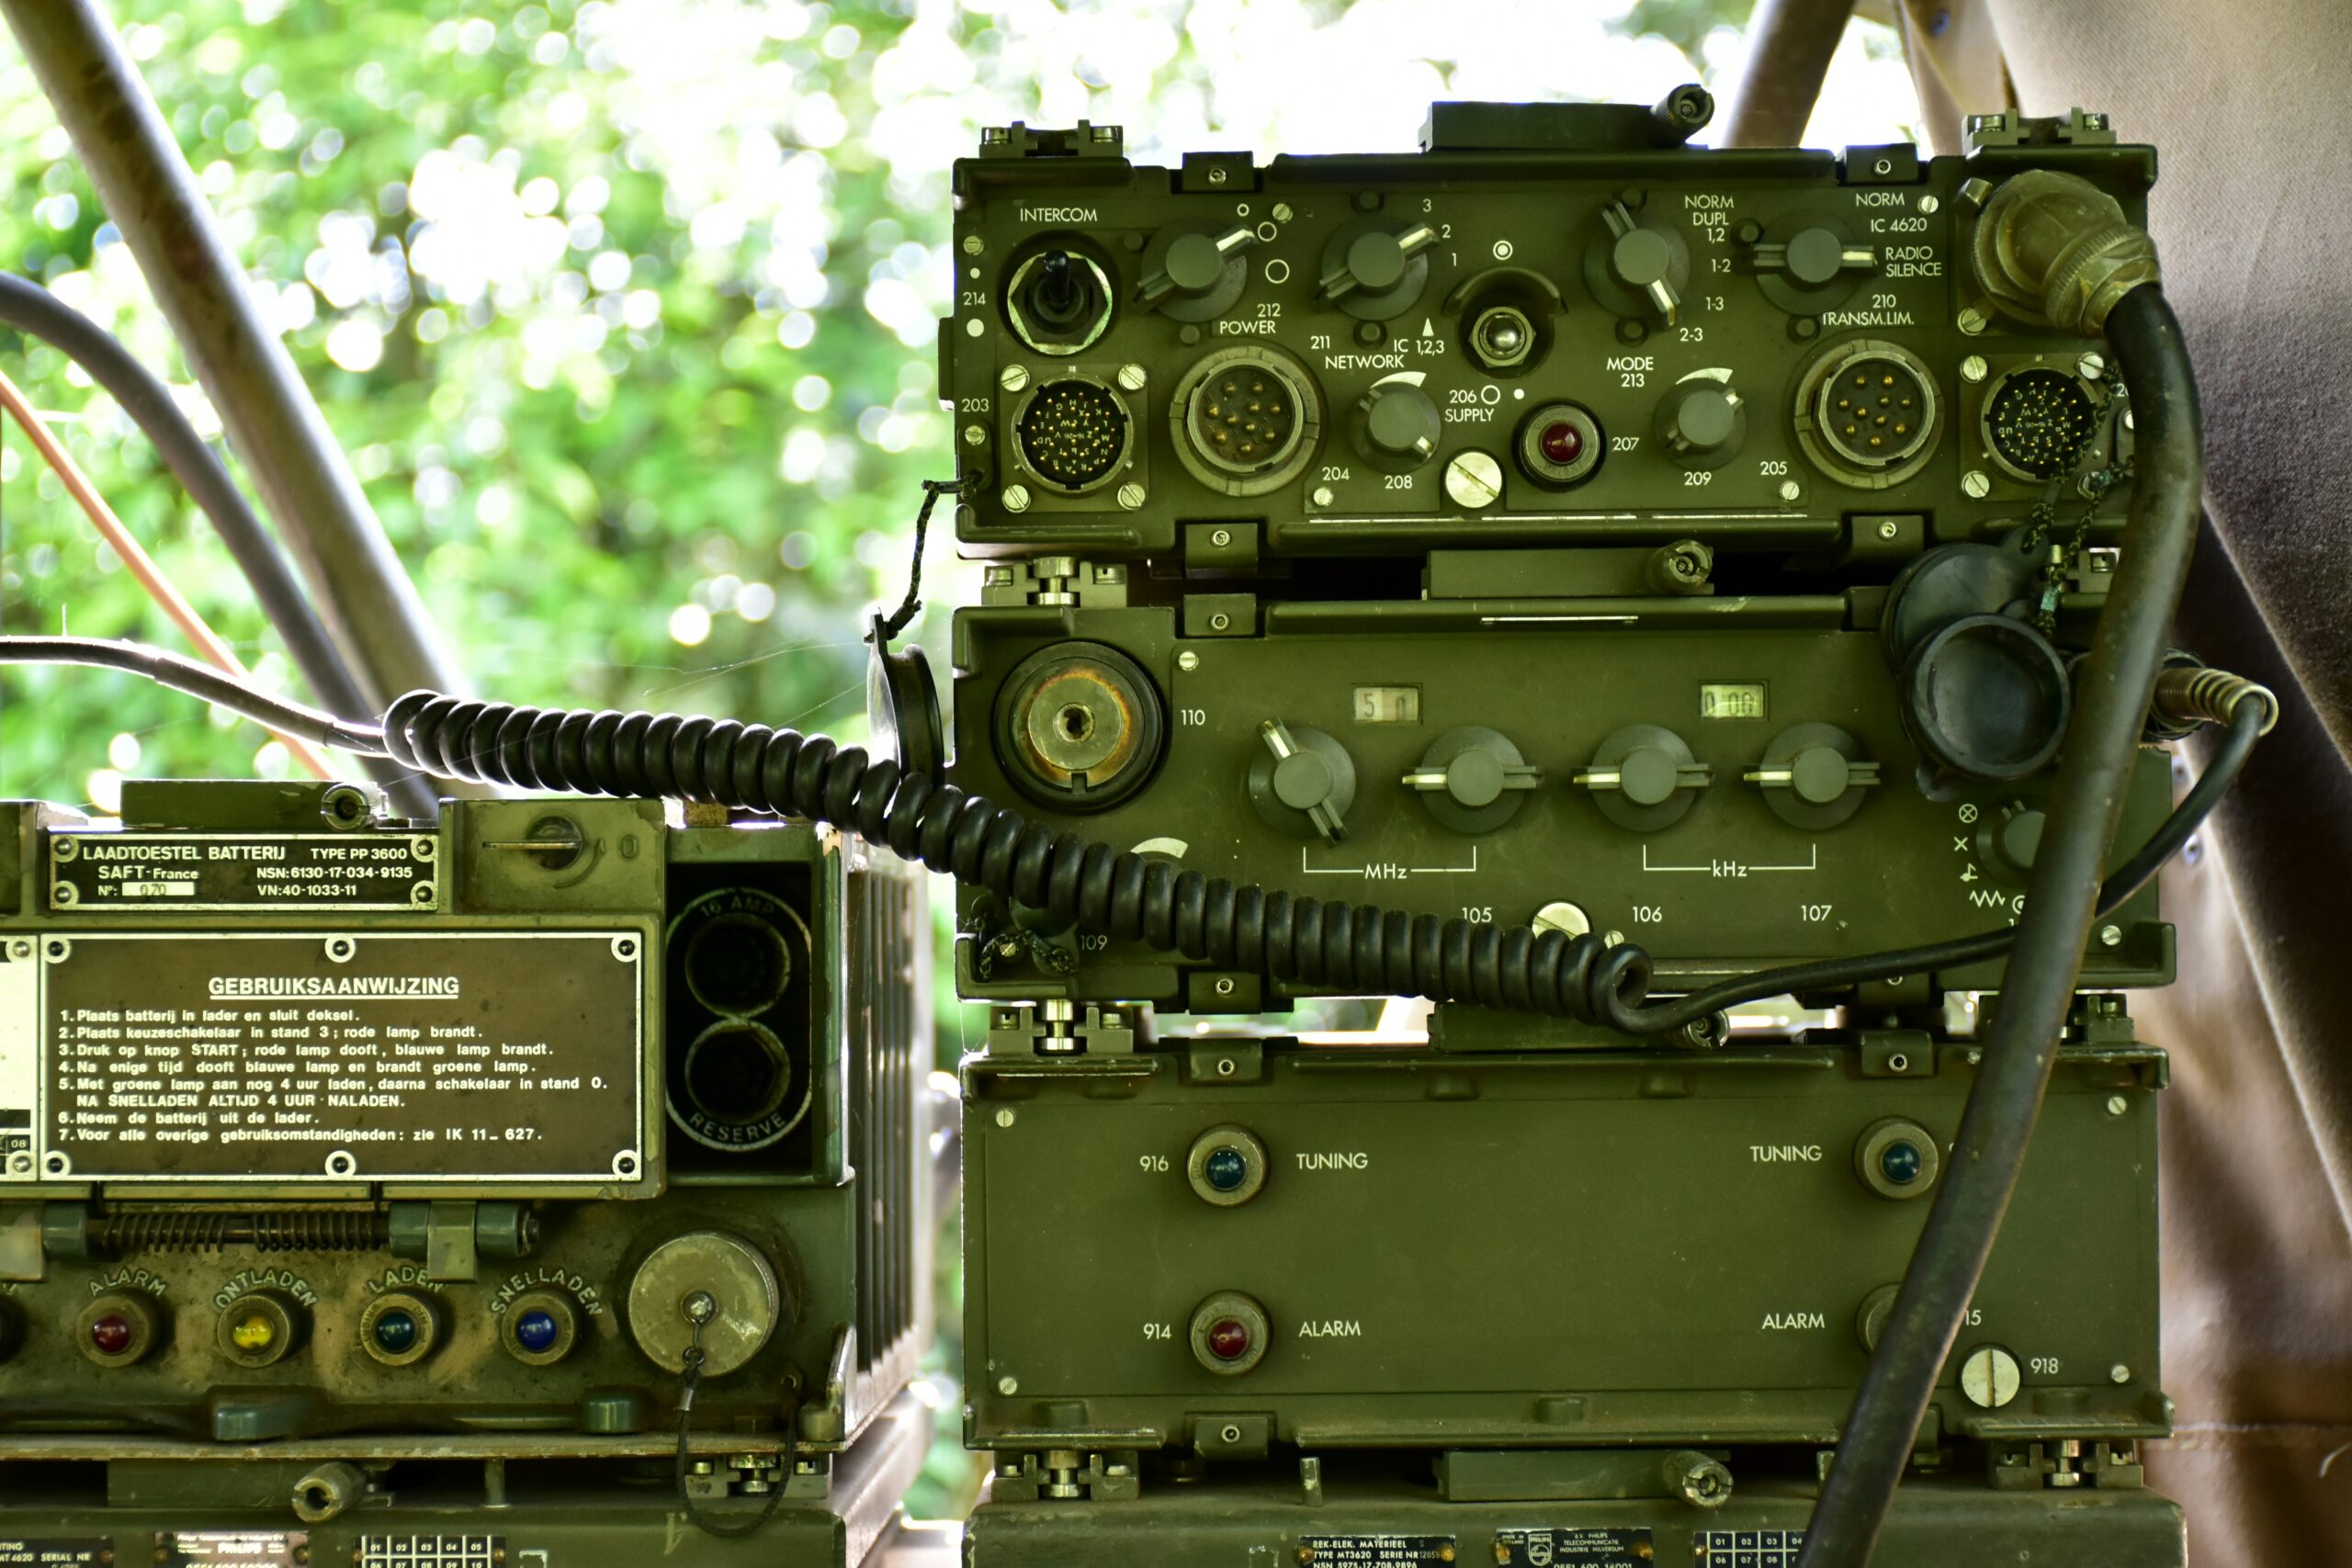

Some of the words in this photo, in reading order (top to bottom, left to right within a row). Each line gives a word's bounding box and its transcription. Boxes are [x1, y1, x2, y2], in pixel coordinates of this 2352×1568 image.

[1422, 198, 1432, 213] 3
[1685, 195, 1735, 209] NORM
[1856, 192, 1905, 207] NORM
[1020, 208, 1097, 222] INTERCOM
[1693, 212, 1729, 226] DUPL
[1442, 225, 1451, 239] 2
[1871, 219, 1885, 232] IC
[1890, 218, 1928, 232] 4620
[1452, 253, 1457, 266] 1
[1885, 246, 1933, 261] RADIO
[1711, 259, 1731, 273] 1-2
[1885, 262, 1942, 276] SILENCE
[963, 292, 986, 306] 214
[1706, 297, 1724, 311] 1-3
[1871, 295, 1896, 309] 210
[1257, 304, 1281, 318] 212
[1220, 321, 1276, 335] POWER
[1679, 328, 1703, 342] 2-3
[1310, 336, 1330, 350] 211
[1394, 339, 1408, 353] IC
[1416, 340, 1444, 355] 1,2,3
[1326, 355, 1405, 369] NETWORK
[1607, 356, 1654, 370] MODE
[1621, 374, 1645, 388] 213
[1449, 389, 1477, 403] 206
[962, 399, 989, 412] 203
[1444, 409, 1495, 423] SUPPLY
[1612, 437, 1640, 451] 207
[1322, 467, 1350, 480] 204
[1759, 461, 1788, 476] 205
[1385, 476, 1413, 490] 208
[1684, 471, 1712, 486] 209
[1181, 709, 1205, 726] 110
[84, 846, 201, 861] LAADTOESTEL
[209, 846, 286, 862] BATTERIJ
[311, 848, 346, 860] TYPE
[350, 848, 368, 860] PP
[371, 848, 407, 861] 3600
[1364, 863, 1407, 879] MHz
[1713, 860, 1747, 877] kHz
[730, 896, 775, 915] AMP
[1462, 907, 1492, 923] 105
[1632, 906, 1662, 922] 106
[1801, 905, 1832, 921] 107
[1080, 935, 1108, 951] 109
[209, 976, 458, 996] GEBRUIKSAANWIJZING
[125, 1010, 176, 1023] batterij
[182, 1010, 195, 1021] in
[202, 1010, 238, 1021] lader
[244, 1013, 261, 1021] en
[269, 1010, 299, 1021] sluit
[126, 1026, 241, 1038] keuzeschakelaar
[251, 1026, 264, 1038] in
[271, 1026, 309, 1038] stand
[344, 1026, 375, 1038] rode
[387, 1026, 420, 1040] lamp
[118, 1047, 137, 1058] op
[144, 1044, 179, 1058] knop
[254, 1044, 286, 1056] rode
[296, 1044, 330, 1058] lamp
[395, 1044, 445, 1056] blauwe
[457, 1044, 491, 1057] lamp
[109, 1061, 148, 1075] enige
[158, 1061, 183, 1075] tijd
[196, 1061, 234, 1073] dooft
[245, 1061, 295, 1073] blauwe
[306, 1061, 340, 1075] lamp
[348, 1064, 365, 1073] en
[376, 1061, 422, 1073] brandt
[433, 1064, 481, 1075] groene
[113, 1081, 162, 1092] groene
[171, 1078, 204, 1092] lamp
[212, 1081, 238, 1090] aan
[246, 1081, 272, 1092] nog
[280, 1078, 290, 1090] 4
[296, 1081, 319, 1090] uur
[378, 1078, 426, 1089] daarna
[435, 1078, 511, 1089] schakelaar
[520, 1078, 533, 1089] in
[540, 1078, 580, 1089] stand
[77, 1095, 97, 1107] NA
[107, 1095, 198, 1107] SNELLADEN
[209, 1095, 259, 1107] ALTIJD
[267, 1095, 277, 1107] 4
[284, 1095, 315, 1107] UUR
[128, 1112, 147, 1124] de
[155, 1112, 207, 1126] batterij
[220, 1112, 239, 1124] uit
[247, 1112, 266, 1124] de
[689, 1111, 786, 1143] RESERVE
[119, 1129, 145, 1141] alle
[155, 1129, 209, 1143] overige
[413, 1129, 435, 1141] zie
[446, 1129, 462, 1141] IK
[11, 1140, 27, 1148] 08
[1750, 1145, 1822, 1162] TUNING
[1139, 1156, 1169, 1172] 916
[1296, 1153, 1368, 1169] TUNING
[88, 1269, 166, 1297] ALARM
[215, 1269, 317, 1309] ONTLADEN
[491, 1267, 603, 1315] SNELLADEN
[1761, 1313, 1826, 1329] ALARM
[1143, 1323, 1171, 1339] 914
[1298, 1320, 1361, 1337] ALARM
[2030, 1358, 2059, 1374] 918
[370, 1543, 381, 1551] 01
[396, 1543, 407, 1551] 02
[421, 1543, 433, 1551] 03
[446, 1543, 458, 1551] 04
[470, 1543, 482, 1551] 05
[1360, 1540, 1407, 1549] MATERIEEL
[1715, 1538, 1726, 1546] 01
[1741, 1538, 1752, 1546] 02
[1766, 1538, 1778, 1546] 03
[11, 1552, 33, 1562] 4620
[40, 1552, 72, 1562] SERIAL
[76, 1552, 91, 1562] NR
